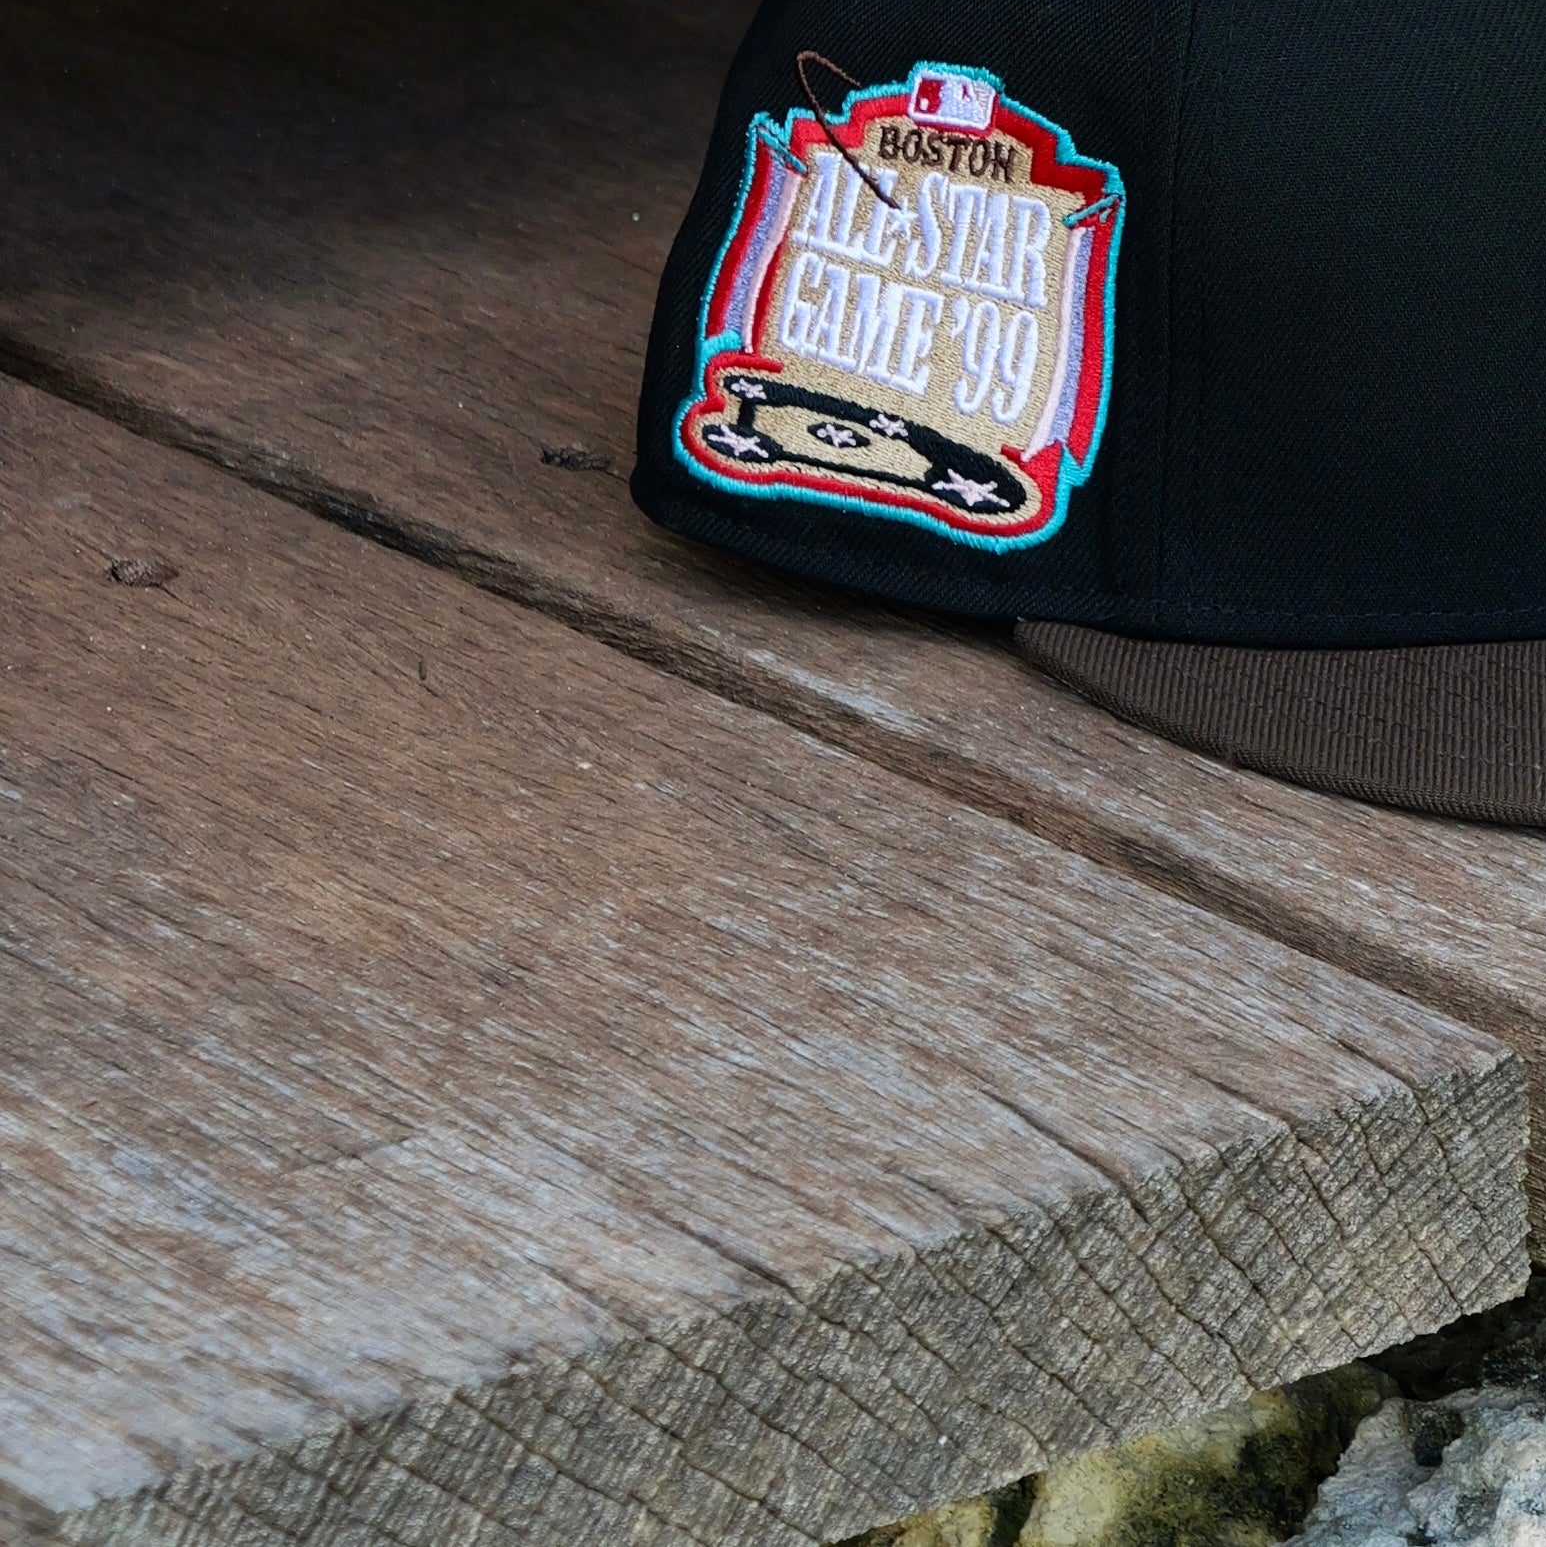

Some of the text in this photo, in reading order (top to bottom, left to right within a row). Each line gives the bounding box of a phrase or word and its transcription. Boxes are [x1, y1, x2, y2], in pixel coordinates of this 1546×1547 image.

[878, 125, 1020, 184] BOSTON
[779, 253, 1040, 425] GAME '99
